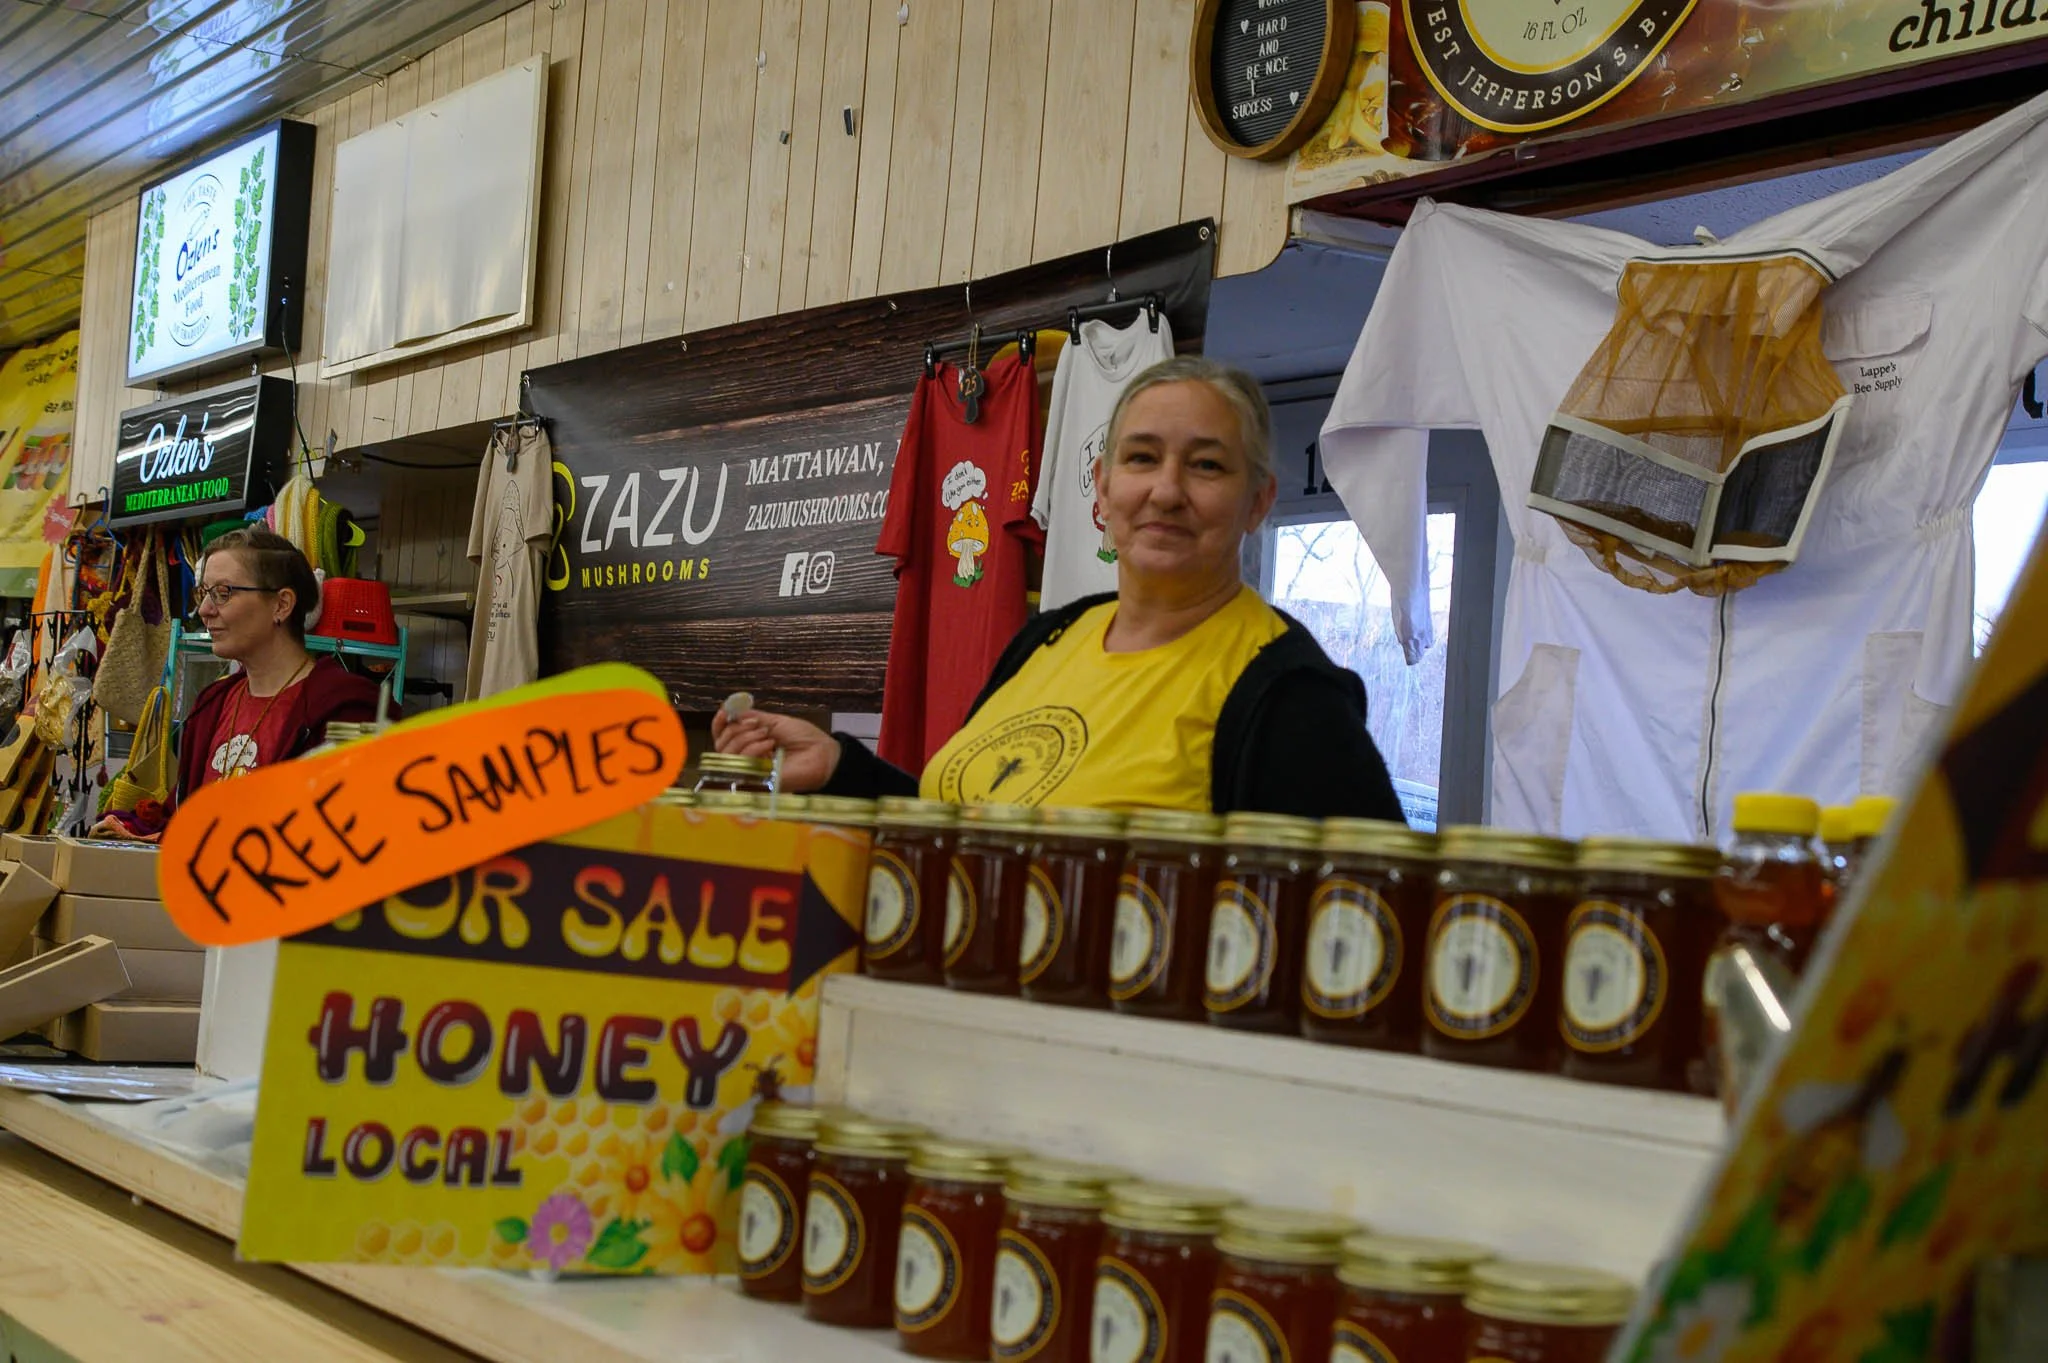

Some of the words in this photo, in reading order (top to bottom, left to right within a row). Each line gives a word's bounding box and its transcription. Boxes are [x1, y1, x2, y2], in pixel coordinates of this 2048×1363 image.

[1257, 17, 1287, 37] HARD
[1523, 21, 1537, 41] 16
[1541, 22, 1556, 40] FL
[1889, 0, 2048, 52] child
[1259, 39, 1279, 56] AND
[1427, 0, 1461, 60] EST
[1458, 65, 1602, 110] JEFFERSON
[1246, 64, 1260, 80] BE
[1265, 56, 1288, 75] NICE
[1232, 98, 1273, 120] SUCCESS
[173, 264, 220, 304] Mediterranean
[186, 290, 203, 317] Food
[1854, 383, 1872, 394] Bee
[1874, 376, 1902, 392] Supply
[1860, 362, 1896, 378] Lappe's
[140, 412, 214, 484] Ozlen's
[745, 441, 885, 486] MATTAWAN,
[125, 482, 200, 512] MEDITERRANEAN
[202, 477, 229, 498] FOOD
[581, 462, 728, 553] ZAZU
[581, 558, 710, 589] MUSHROOMS
[186, 782, 387, 924] FREE
[395, 716, 664, 833] SAMPLES
[333, 856, 532, 949] OR
[561, 865, 792, 974] SALE
[308, 990, 749, 1109] HONEY
[301, 1116, 523, 1188] LOCAL
